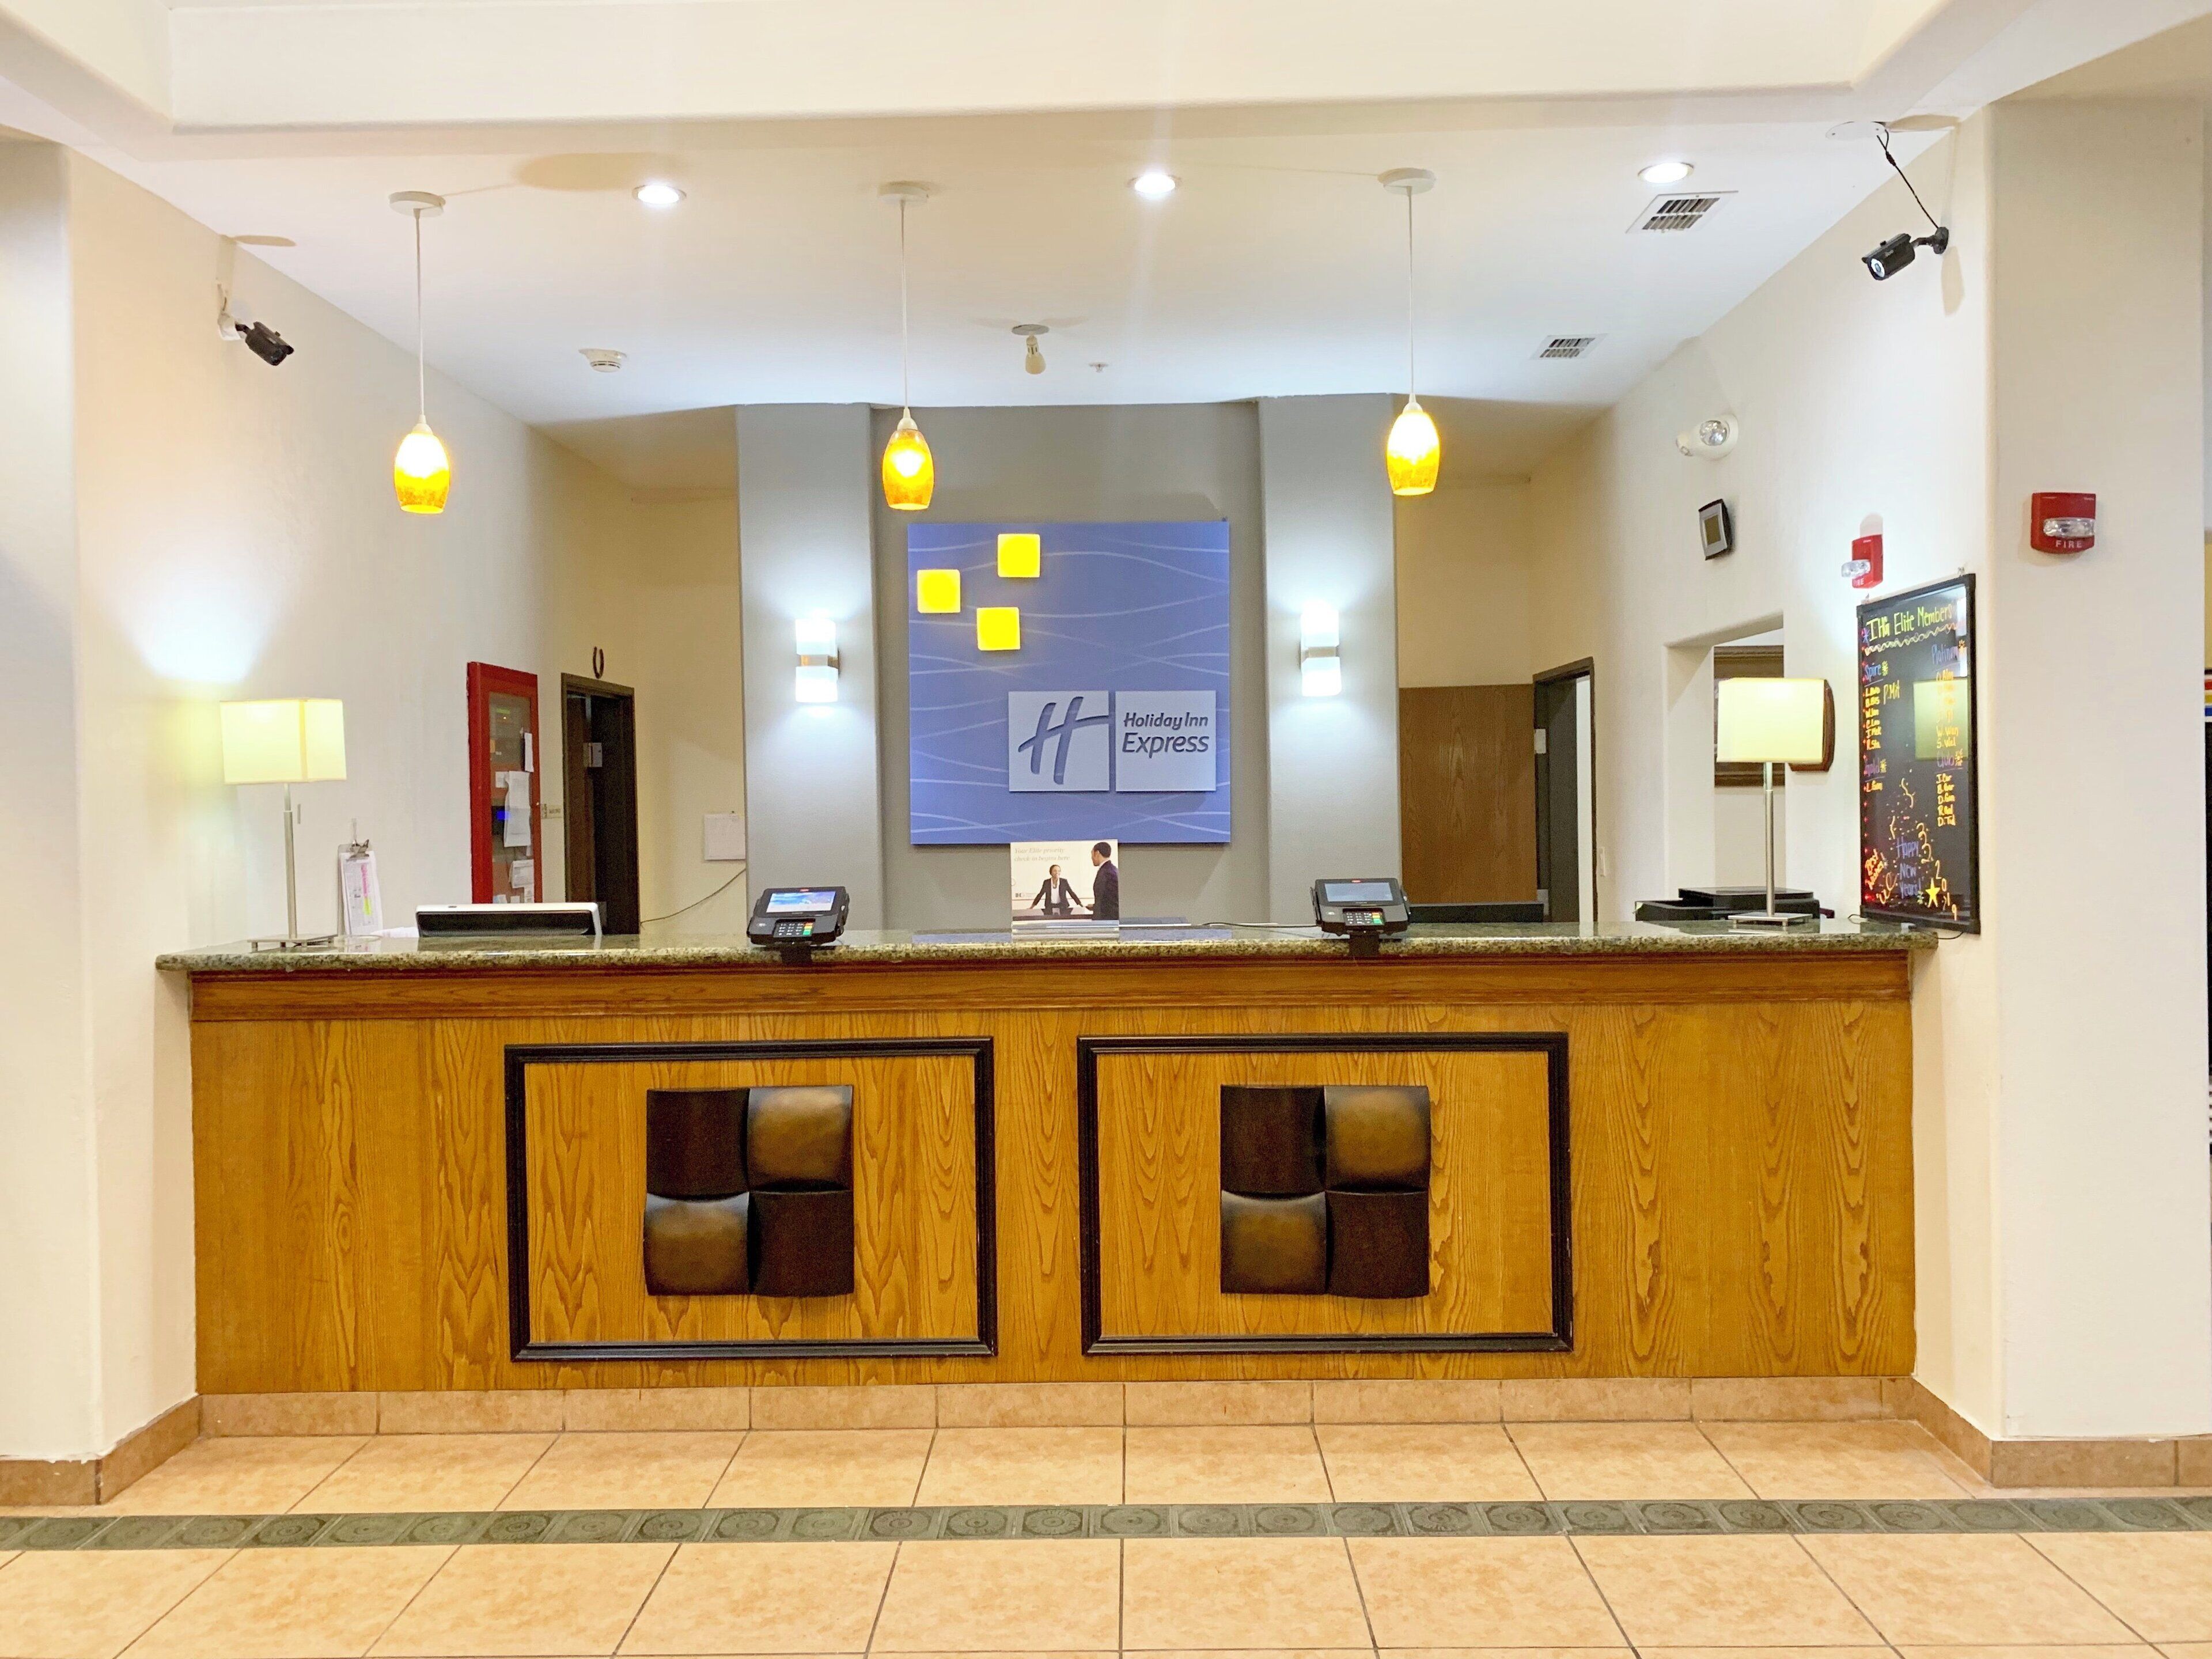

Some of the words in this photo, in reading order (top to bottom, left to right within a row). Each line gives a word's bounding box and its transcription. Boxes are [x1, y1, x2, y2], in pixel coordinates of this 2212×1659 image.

[2055, 540, 2082, 548] FIRE
[1894, 611, 1915, 635] Elite
[1917, 604, 1952, 628] Members
[1865, 662, 1881, 682] Spire
[1123, 712, 1182, 730] Holiday
[1185, 712, 1208, 726] Inn
[1122, 732, 1209, 758] Express
[1896, 836, 1919, 859] Happy
[1900, 863, 1916, 880] New
